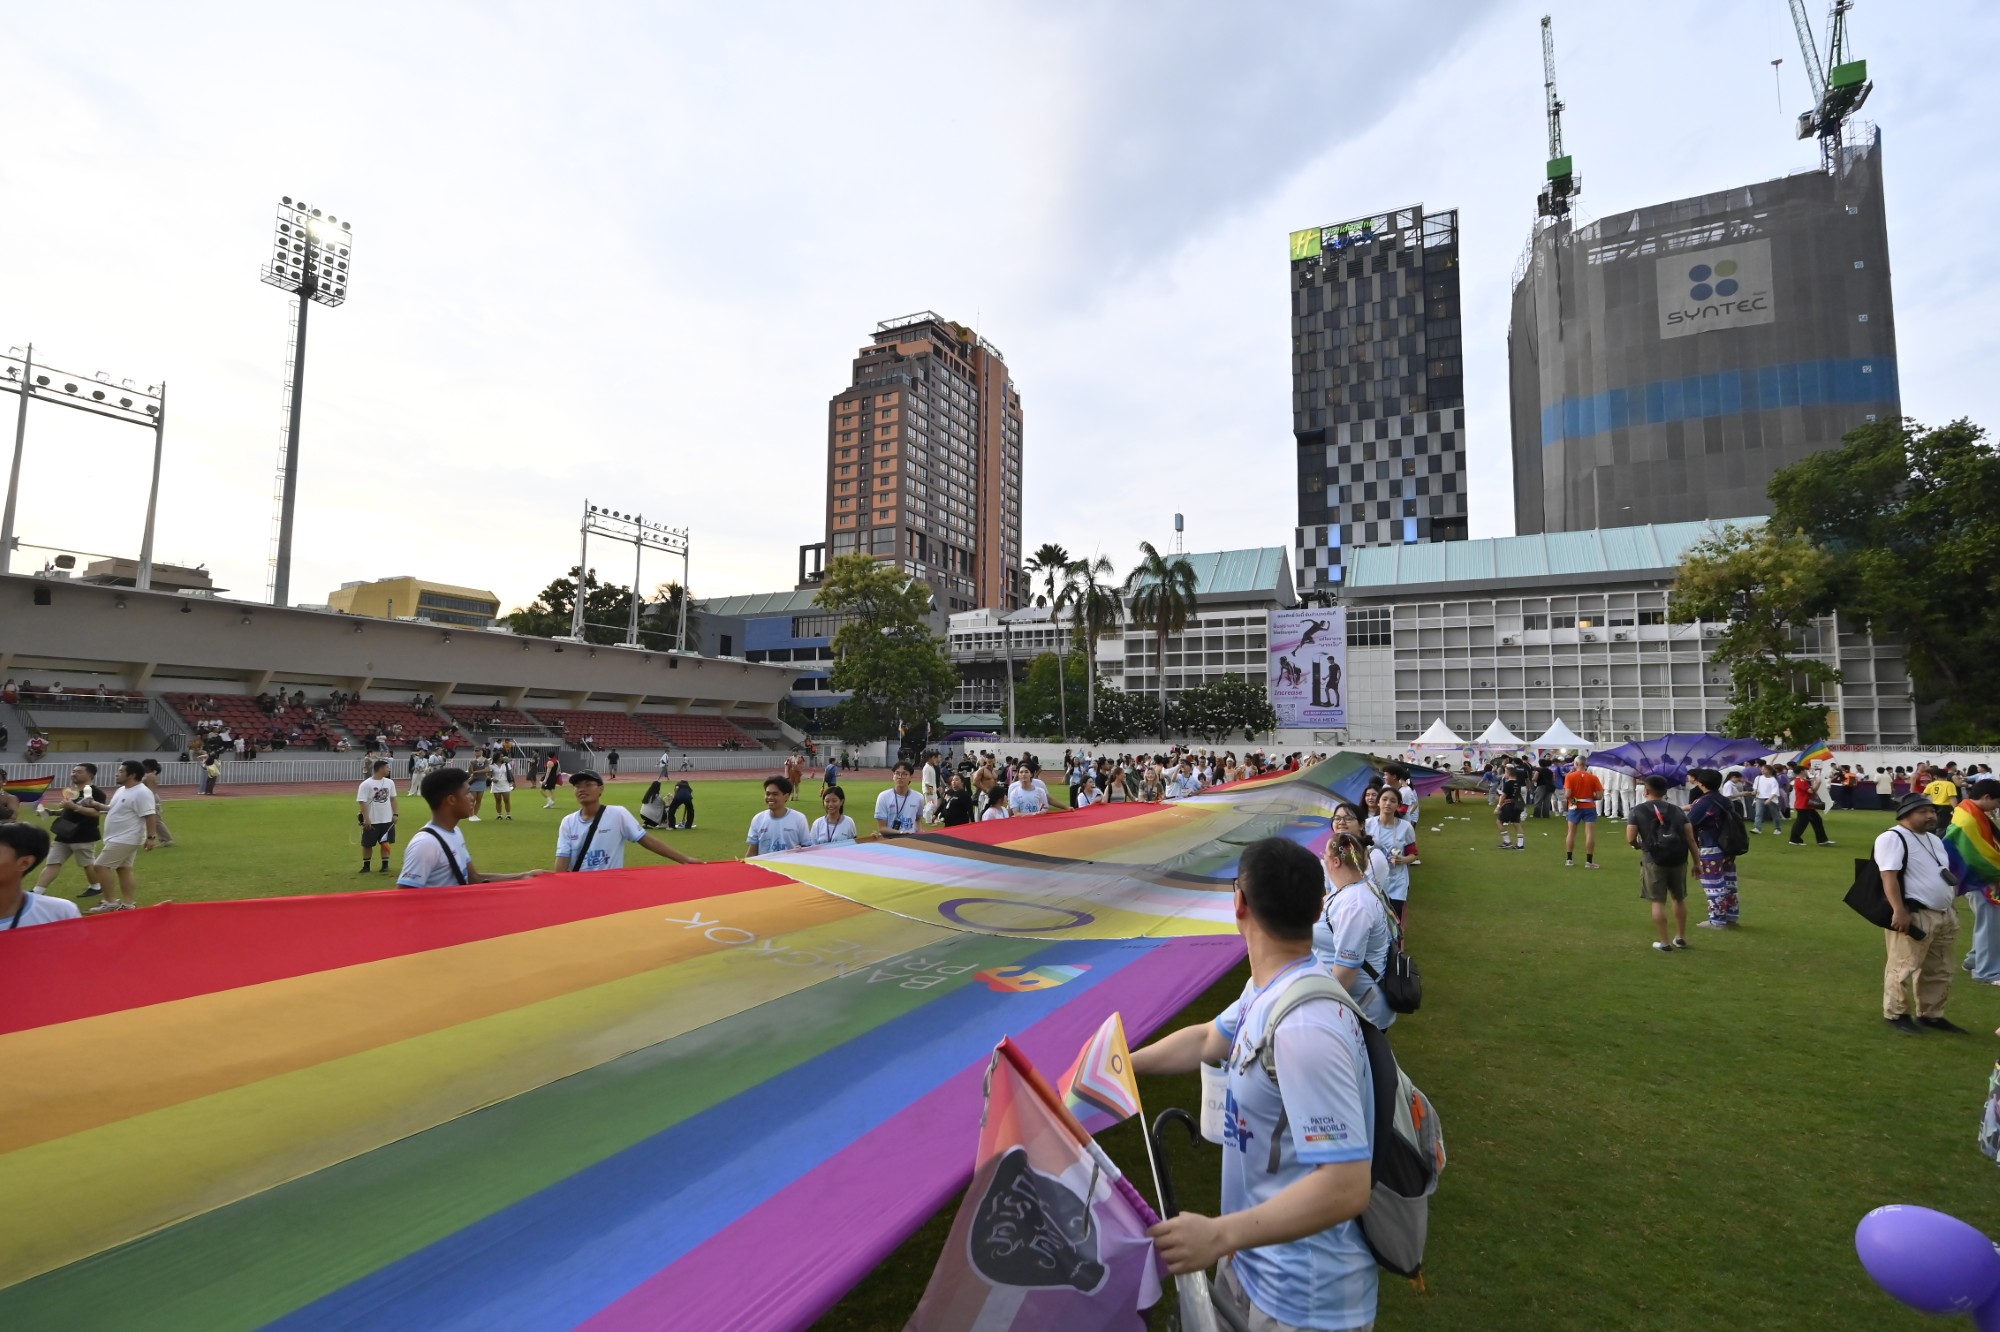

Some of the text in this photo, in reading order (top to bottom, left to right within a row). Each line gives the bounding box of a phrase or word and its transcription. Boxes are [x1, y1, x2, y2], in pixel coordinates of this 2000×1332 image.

[1274, 689, 1303, 697] Increase
[1310, 1116, 1335, 1125] PATCH
[1303, 1123, 1347, 1133] THE WORLD
